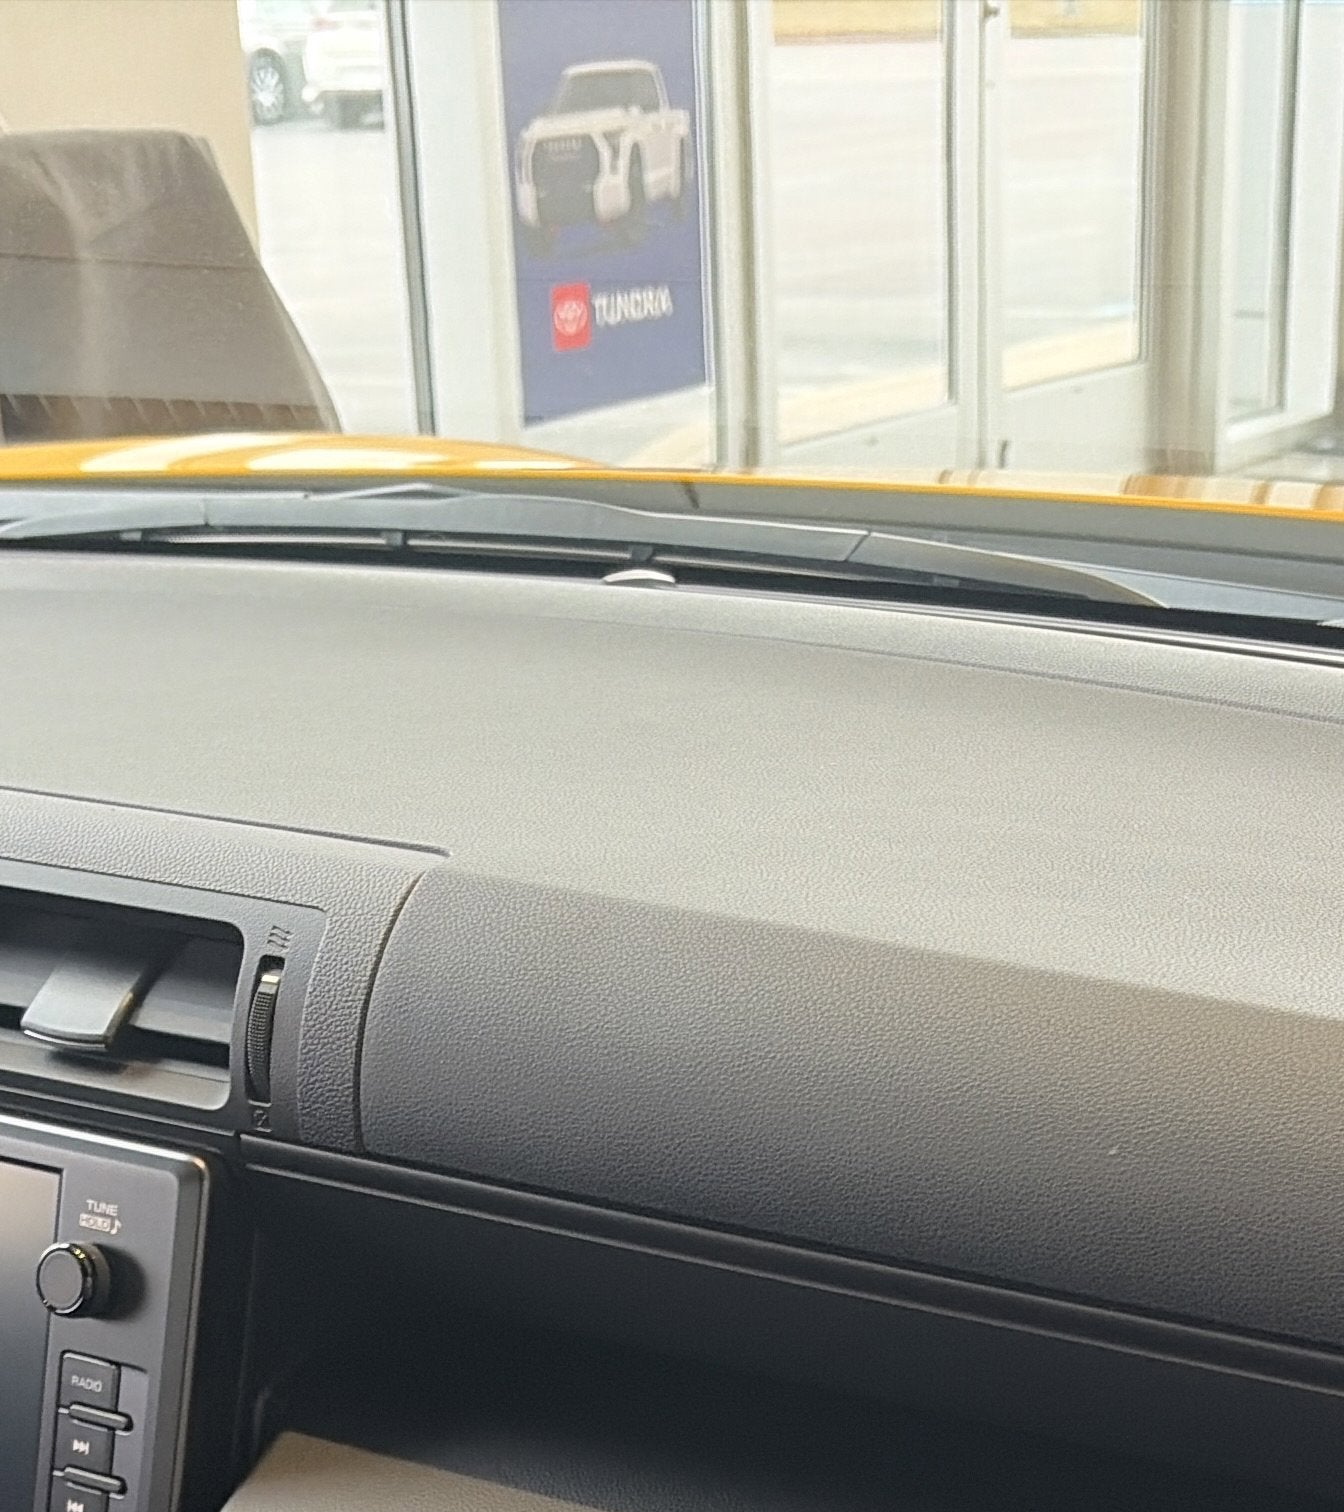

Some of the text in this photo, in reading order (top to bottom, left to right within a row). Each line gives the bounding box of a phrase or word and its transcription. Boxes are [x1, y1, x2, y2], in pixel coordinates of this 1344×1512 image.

[592, 285, 673, 327] TUNDRA
[86, 1199, 119, 1217] TUNE
[71, 1375, 103, 1393] RADIO
